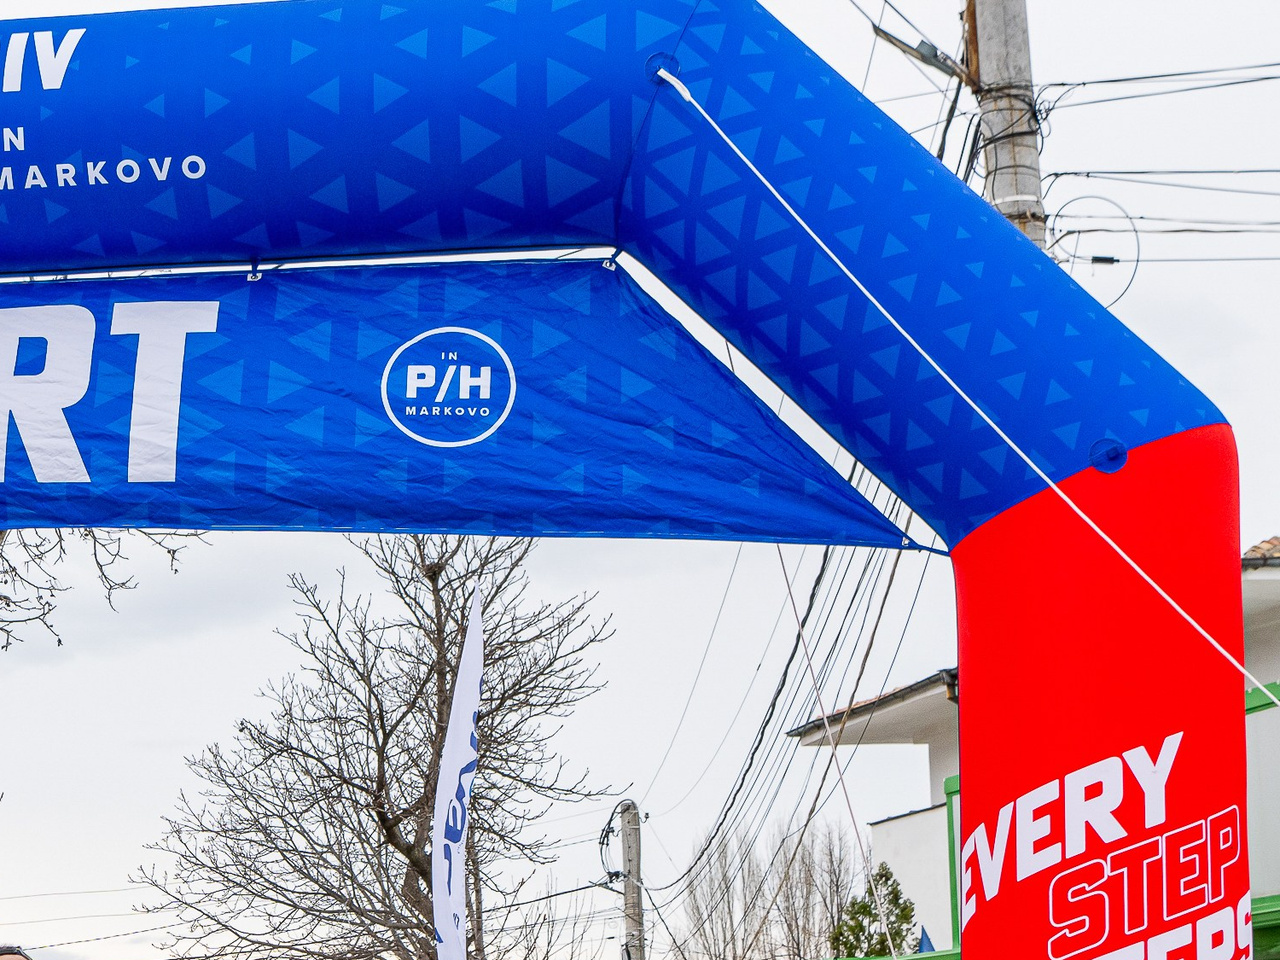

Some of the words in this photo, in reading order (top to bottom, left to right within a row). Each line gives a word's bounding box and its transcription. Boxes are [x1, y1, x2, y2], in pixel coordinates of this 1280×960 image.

[441, 351, 458, 361] IN
[405, 365, 492, 403] P/H
[405, 406, 491, 417] MARKOVO
[961, 731, 1184, 933] EVERY
